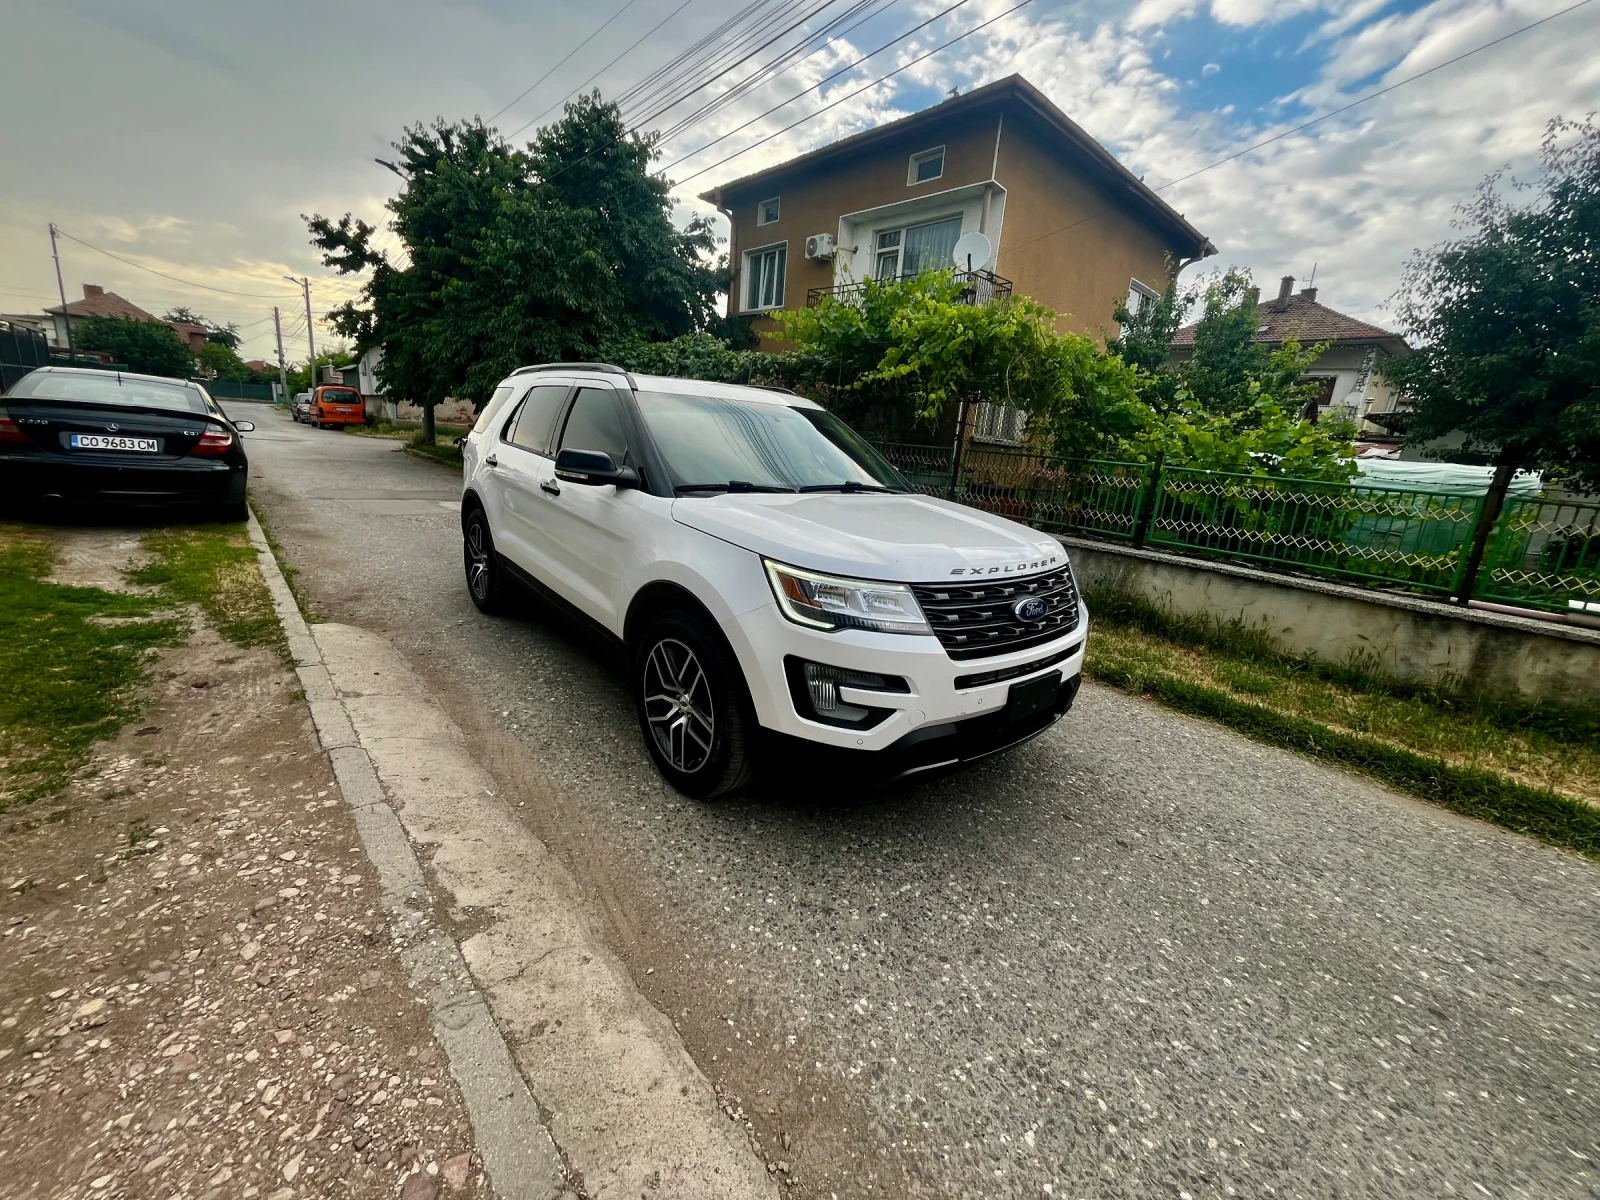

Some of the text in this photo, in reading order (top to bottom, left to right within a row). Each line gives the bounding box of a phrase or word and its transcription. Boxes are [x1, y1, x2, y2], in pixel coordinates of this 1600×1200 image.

[80, 436, 99, 447] CO
[101, 437, 135, 449] 9683
[137, 440, 156, 451] CM
[949, 556, 1056, 575] EXPLORER
[1025, 601, 1044, 617] Ford
